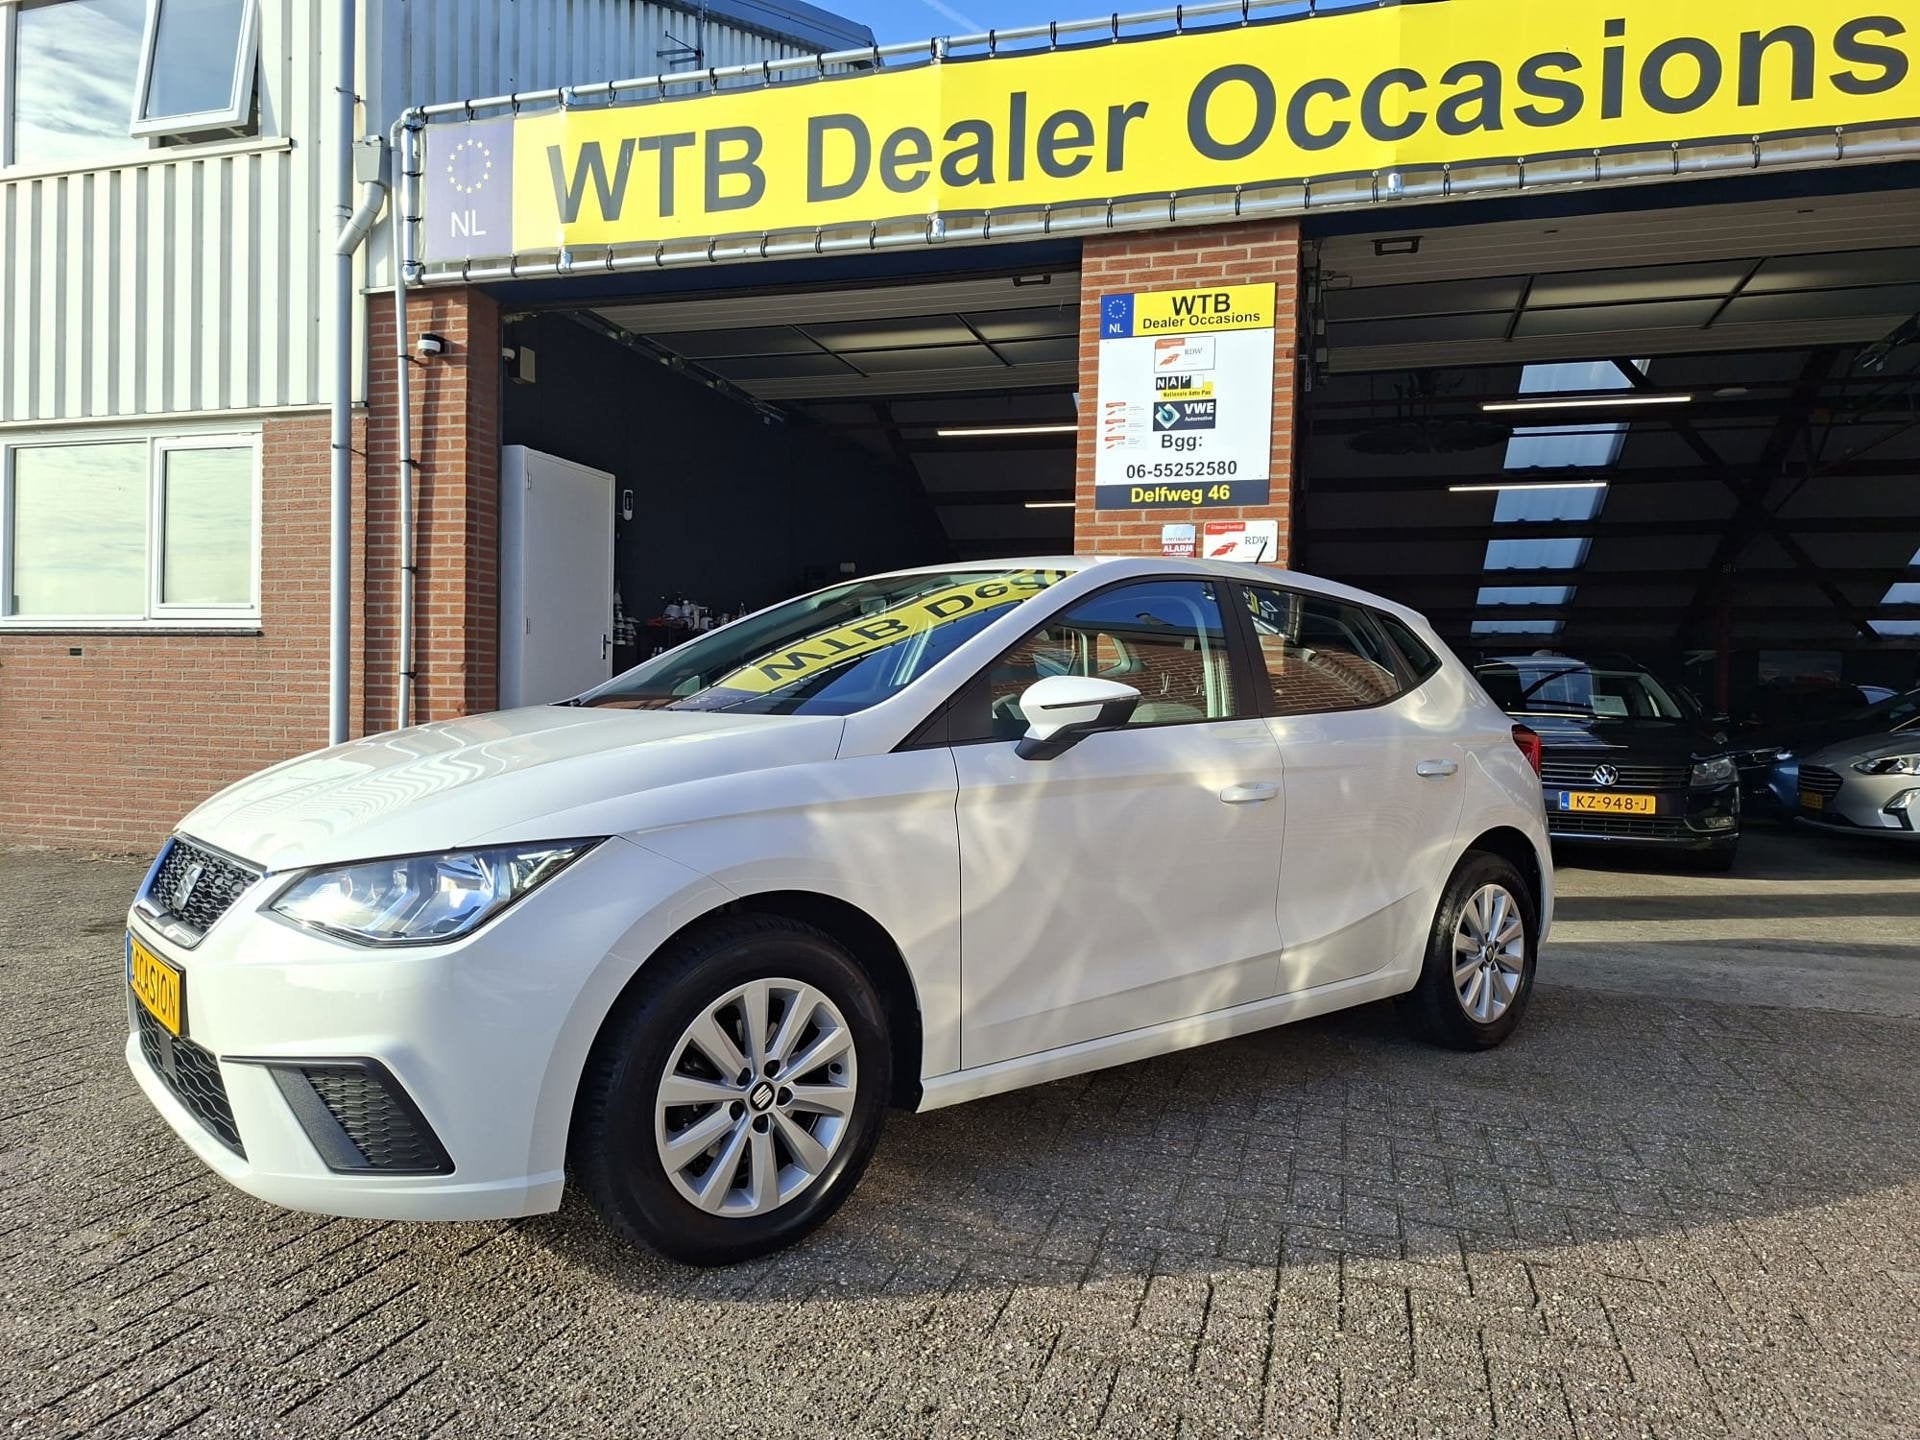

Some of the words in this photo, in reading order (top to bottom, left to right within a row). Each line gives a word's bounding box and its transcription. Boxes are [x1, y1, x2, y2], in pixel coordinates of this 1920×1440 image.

[546, 125, 767, 224] WTB
[807, 93, 1148, 203] Dealer
[1186, 15, 1910, 161] Occasions
[450, 210, 486, 239] NL
[1171, 293, 1231, 316] WTB
[1109, 323, 1124, 334] NL
[1143, 317, 1185, 329] Dealer
[1189, 312, 1261, 325] Occasions
[1156, 375, 1191, 389] NAP
[1184, 402, 1215, 414] VWE
[1161, 434, 1203, 451] Bgg:
[1126, 460, 1238, 478] 06-55252580
[1131, 486, 1203, 504] Delfweg
[1208, 484, 1231, 500] 46
[1162, 544, 1194, 552] ALARM
[1244, 535, 1269, 545] RDW
[1576, 795, 1648, 811] KZ-948-J
